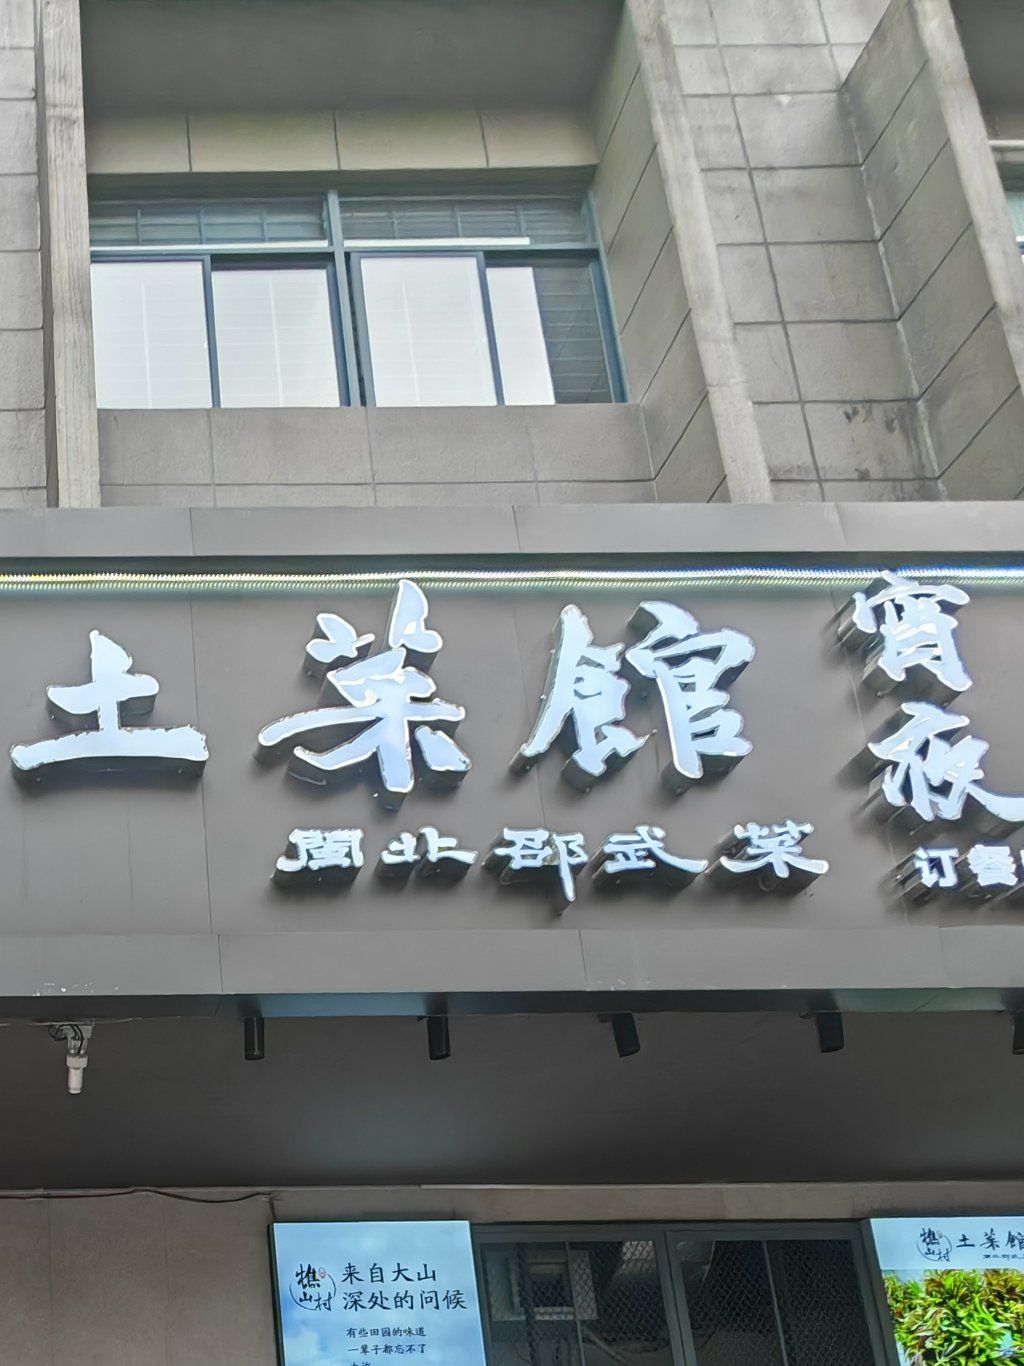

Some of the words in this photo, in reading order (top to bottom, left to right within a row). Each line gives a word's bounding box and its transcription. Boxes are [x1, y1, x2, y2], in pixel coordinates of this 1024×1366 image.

[913, 843, 1024, 888] 订餐
[341, 1262, 436, 1285] 来自大山
[343, 1290, 468, 1312] 深处的问候
[346, 1326, 427, 1338] 有些田园的味道
[348, 1343, 426, 1355] 一辈子都忘不了
